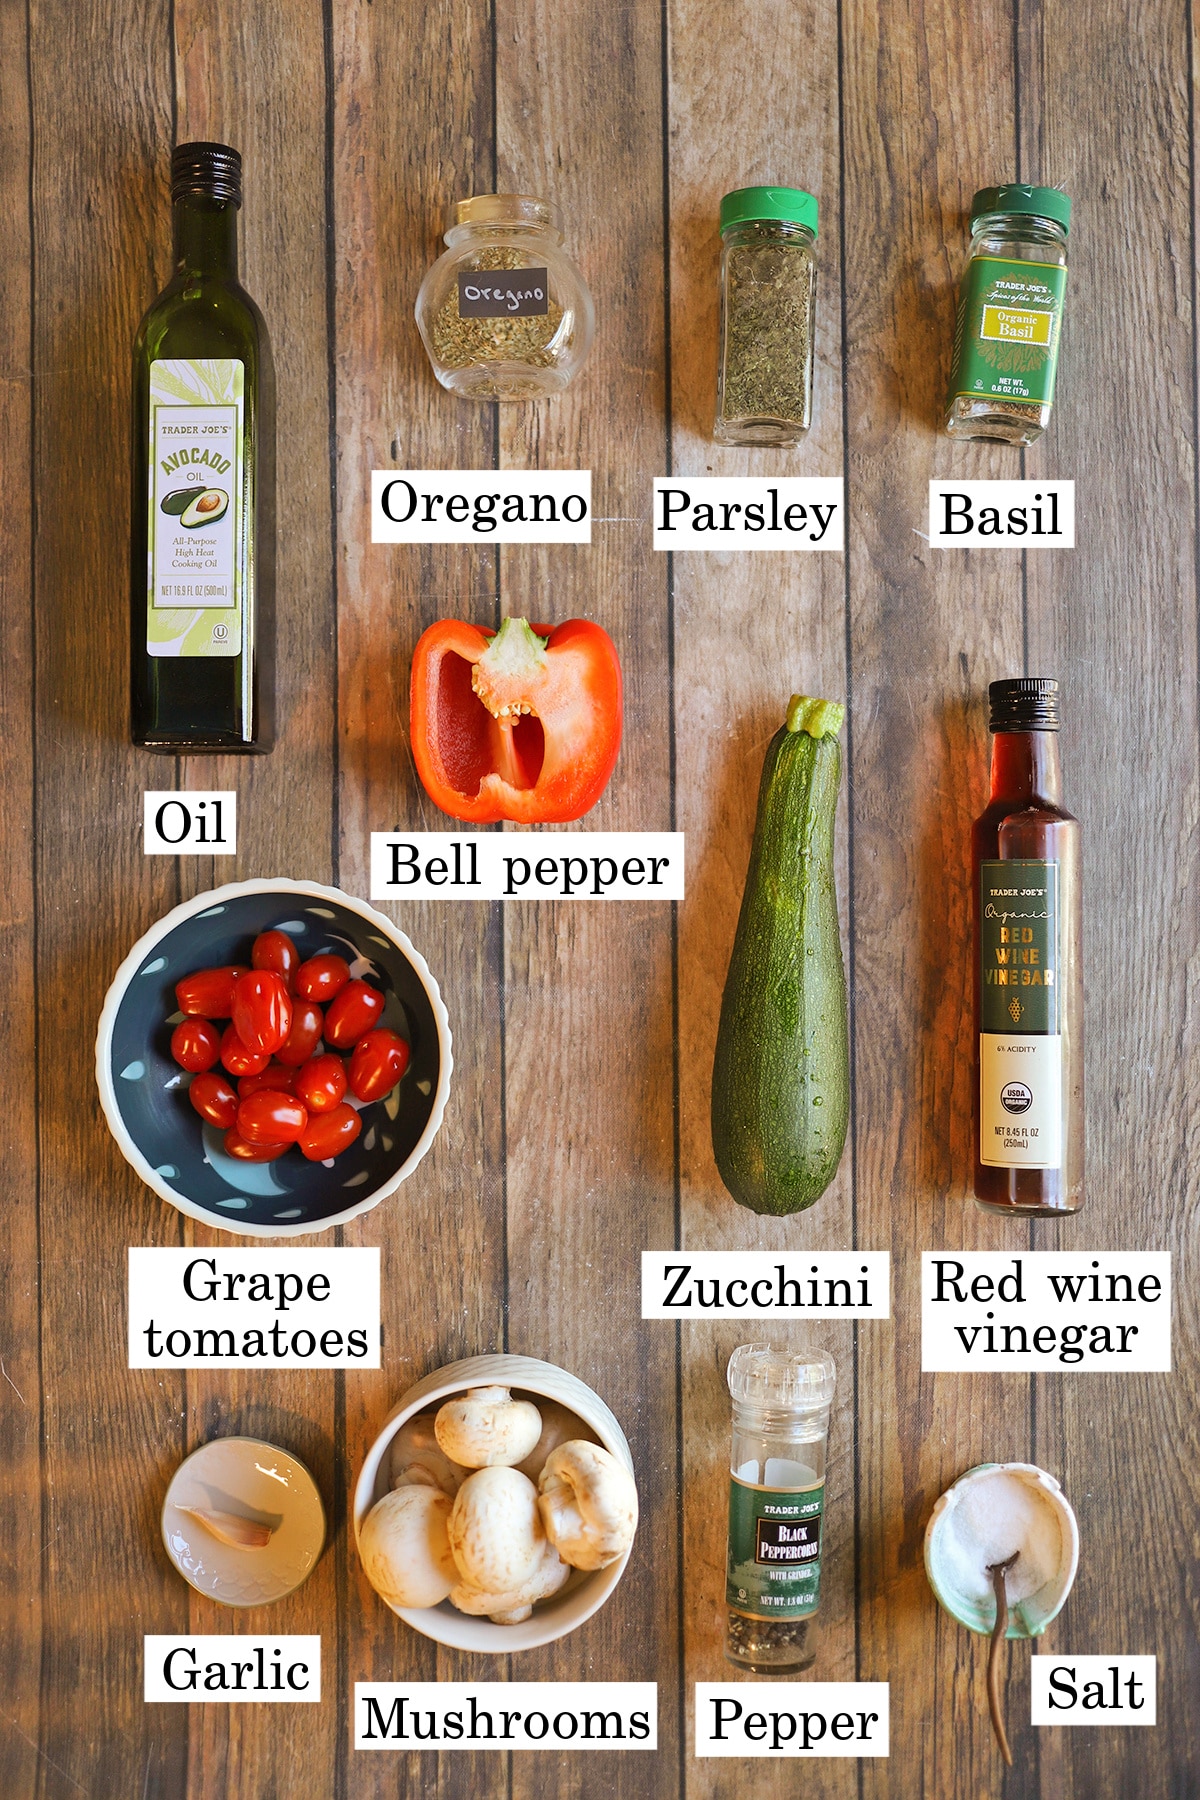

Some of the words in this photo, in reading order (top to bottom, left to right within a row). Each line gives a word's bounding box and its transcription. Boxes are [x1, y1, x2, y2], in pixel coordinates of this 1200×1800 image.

[995, 281, 1025, 291] TRADER
[465, 285, 544, 311] Oregano
[997, 311, 1038, 325] Organic
[999, 322, 1034, 339] Basil
[999, 377, 1012, 385] NET
[991, 384, 1002, 392] 0.6
[1012, 387, 1029, 396] (17g)
[162, 426, 199, 434] TRADER
[160, 447, 231, 476] AVOCADO
[186, 472, 204, 481] OIL
[172, 537, 217, 546] All-Purpose
[175, 548, 194, 558] High
[195, 548, 214, 556] Heat
[171, 559, 203, 569] Cooking
[204, 559, 217, 567] Oil
[161, 585, 172, 596] NET
[174, 585, 187, 596] 16.9
[187, 585, 194, 596] FL
[195, 585, 203, 596] OZ
[985, 903, 1053, 924] Organic
[1000, 927, 1034, 944] RED
[995, 948, 1040, 965] WINE
[985, 969, 1054, 986] VINEGAR
[1007, 1089, 1025, 1097] USDA
[995, 1126, 1005, 1135] NET
[1006, 1127, 1020, 1136] 8.45
[1021, 1128, 1029, 1137] FL
[1030, 1128, 1039, 1137] OZ
[1003, 1138, 1028, 1149] (250mL)
[764, 1505, 799, 1514] TRADER
[760, 1595, 773, 1605] NET
